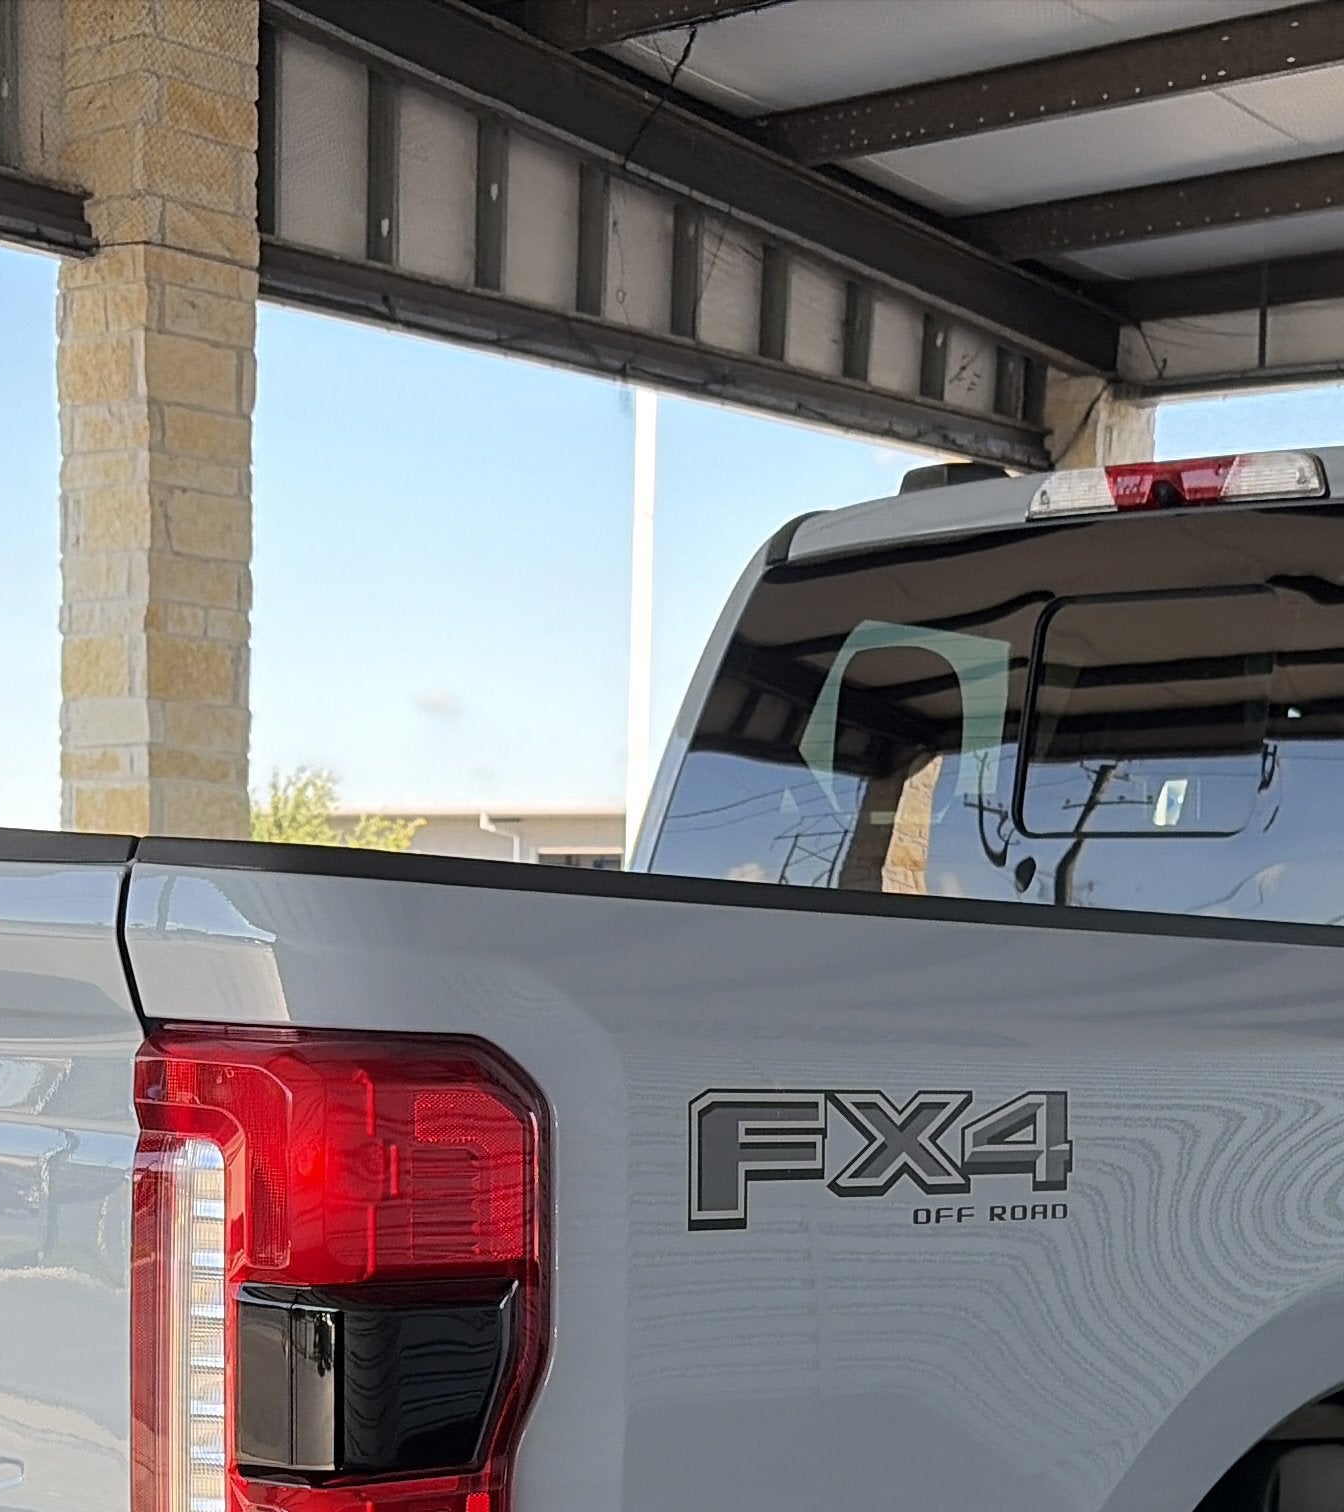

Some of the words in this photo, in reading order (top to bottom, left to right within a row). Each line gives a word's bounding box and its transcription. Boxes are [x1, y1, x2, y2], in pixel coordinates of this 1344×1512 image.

[688, 1088, 1073, 1231] FX4
[913, 1206, 975, 1225] OFF
[989, 1203, 1068, 1222] ROAD
